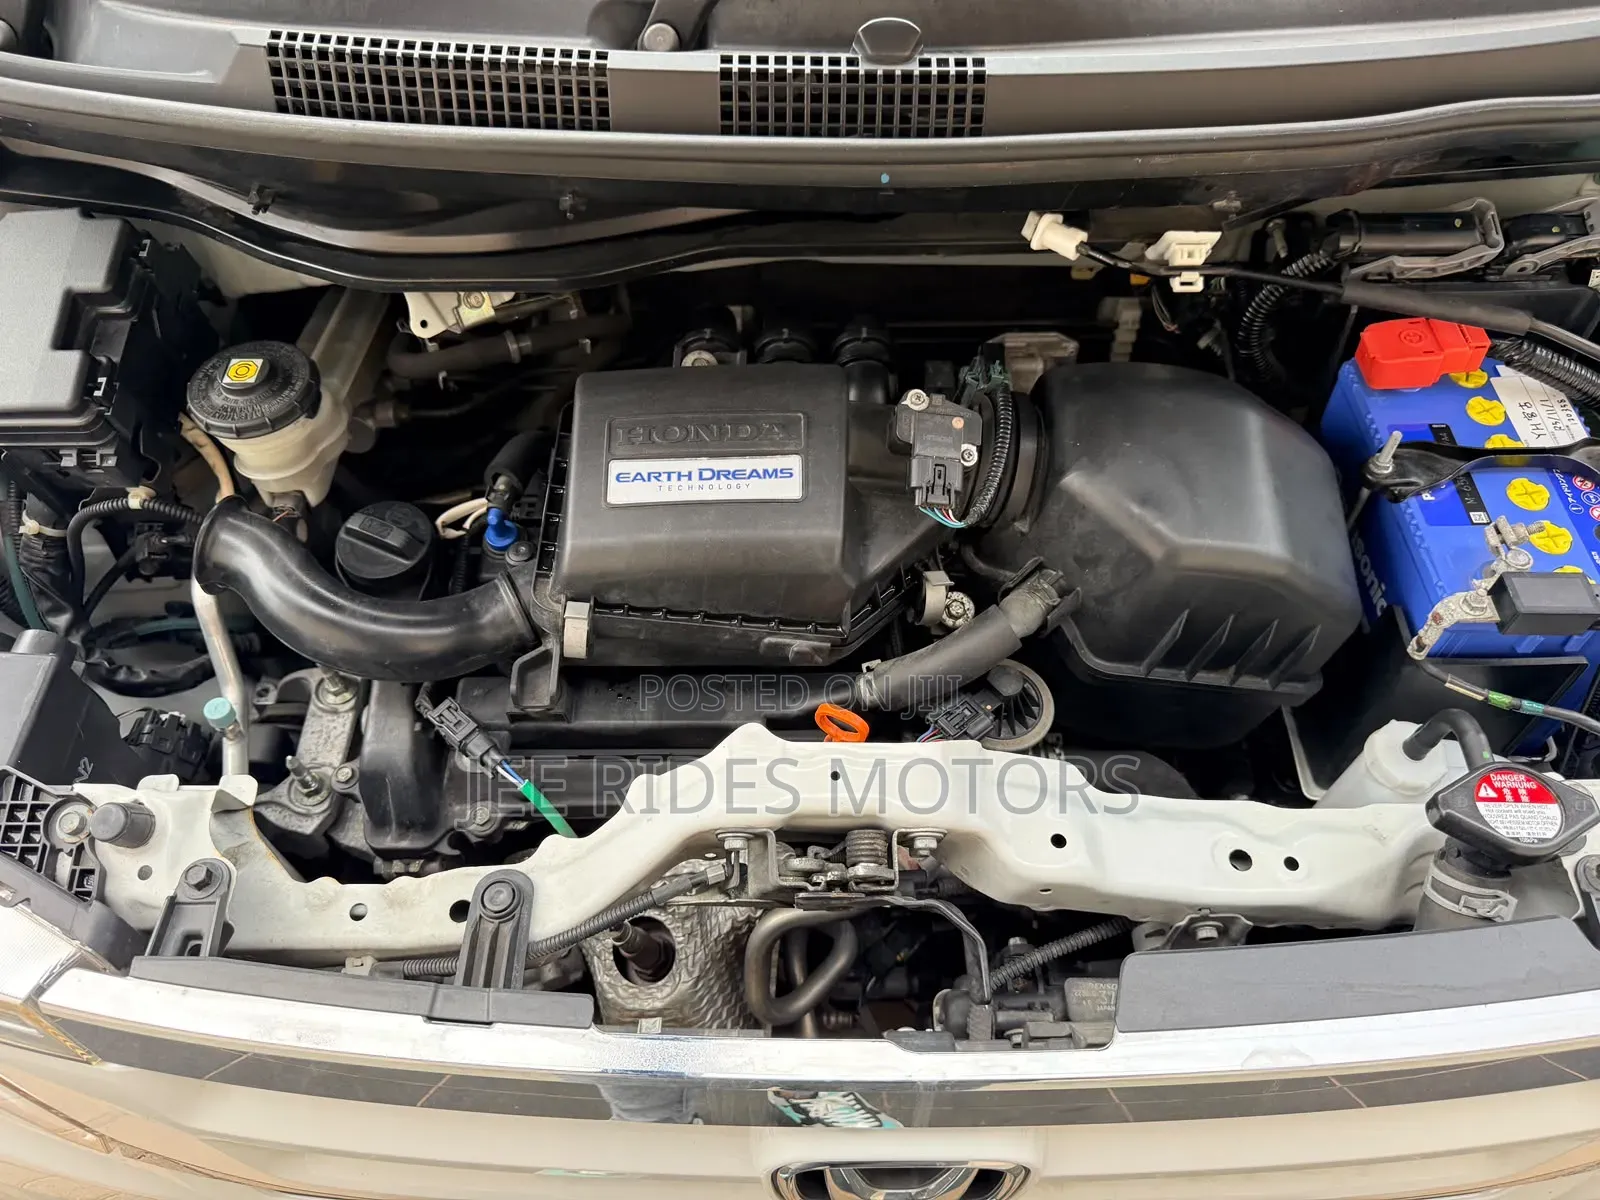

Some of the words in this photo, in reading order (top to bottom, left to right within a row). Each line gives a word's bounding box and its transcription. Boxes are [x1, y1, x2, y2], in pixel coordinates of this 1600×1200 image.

[616, 422, 795, 446] HONDA
[615, 471, 693, 483] EARTH
[698, 467, 794, 481] DREAMS
[658, 483, 751, 492] TECHNOLOGY
[1490, 774, 1526, 782] DANGER
[1493, 781, 1537, 789] WARNUNG
